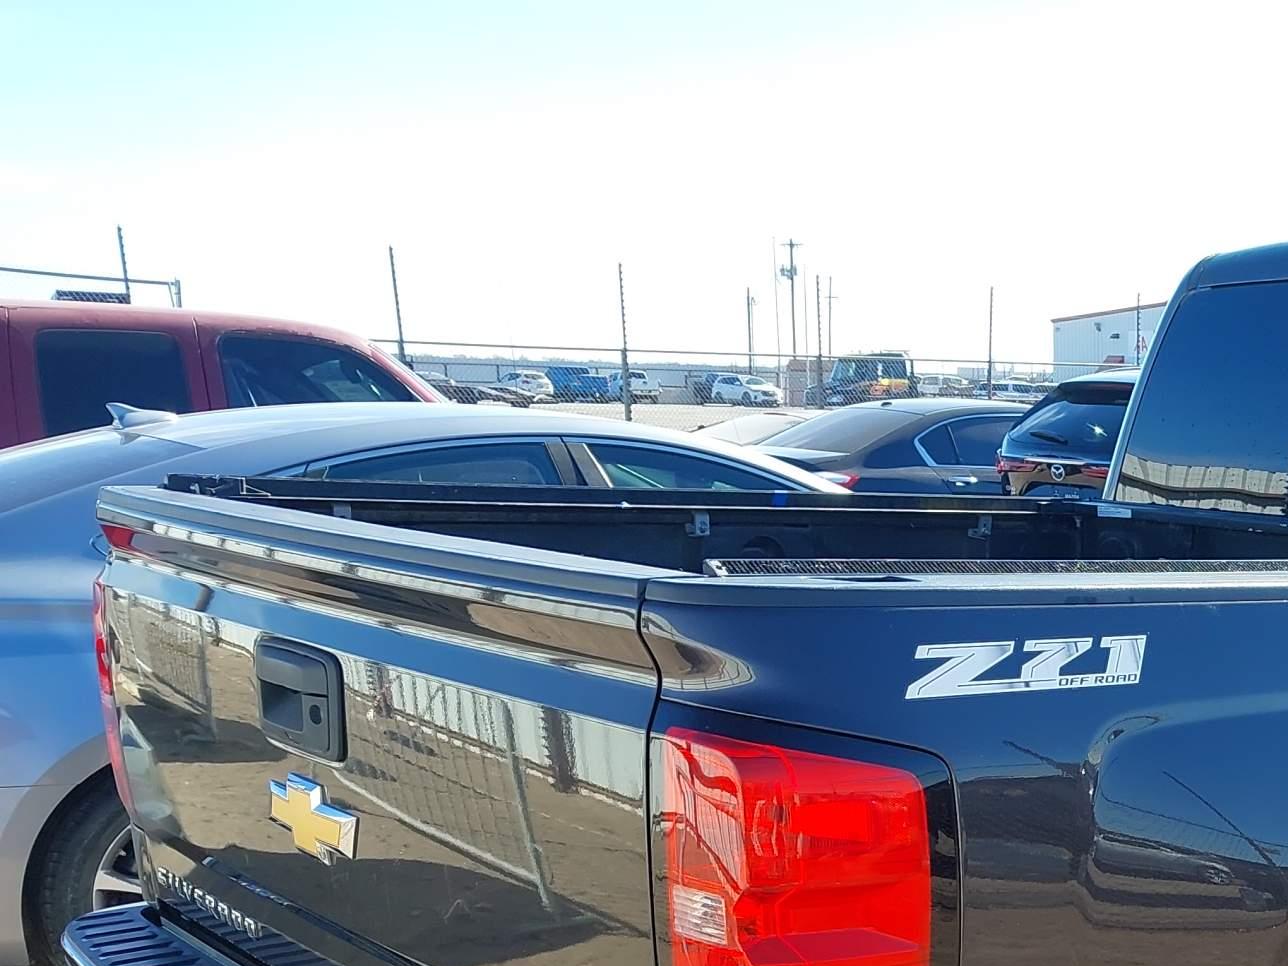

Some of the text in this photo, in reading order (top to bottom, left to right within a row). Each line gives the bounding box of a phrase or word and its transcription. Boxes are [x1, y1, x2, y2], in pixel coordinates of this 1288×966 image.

[906, 635, 1147, 699] Z71
[1058, 673, 1138, 687] OFF ROAD
[157, 867, 262, 939] SILVERADO
